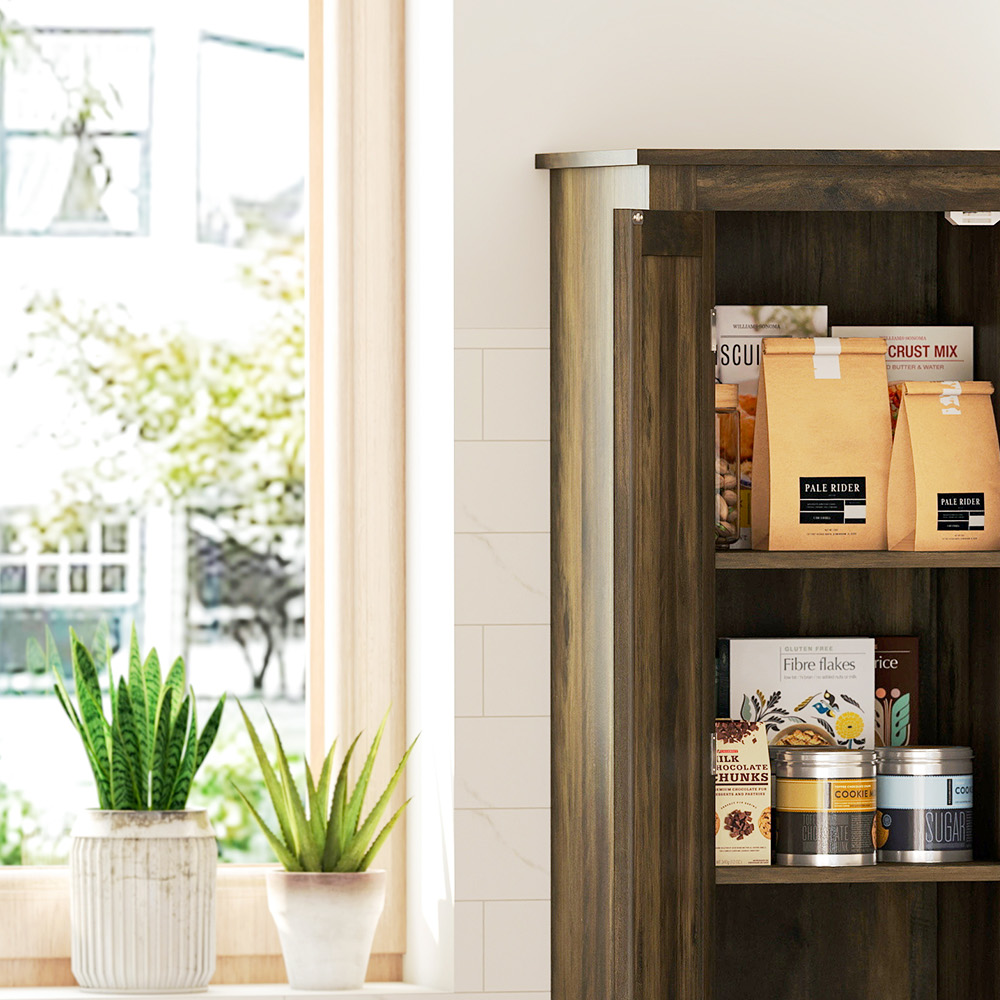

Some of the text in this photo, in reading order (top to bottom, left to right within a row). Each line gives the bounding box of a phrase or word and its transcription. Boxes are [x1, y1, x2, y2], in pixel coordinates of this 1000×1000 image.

[715, 344, 760, 366] SCUI
[888, 344, 958, 358] CRUST MIX
[804, 483, 861, 493] PALE RIDER
[940, 497, 981, 506] PALE RIDER
[783, 656, 856, 671] Fibre flakes
[874, 655, 899, 669] rice
[834, 790, 869, 799] COOKIE
[925, 811, 966, 843] SUGAR
